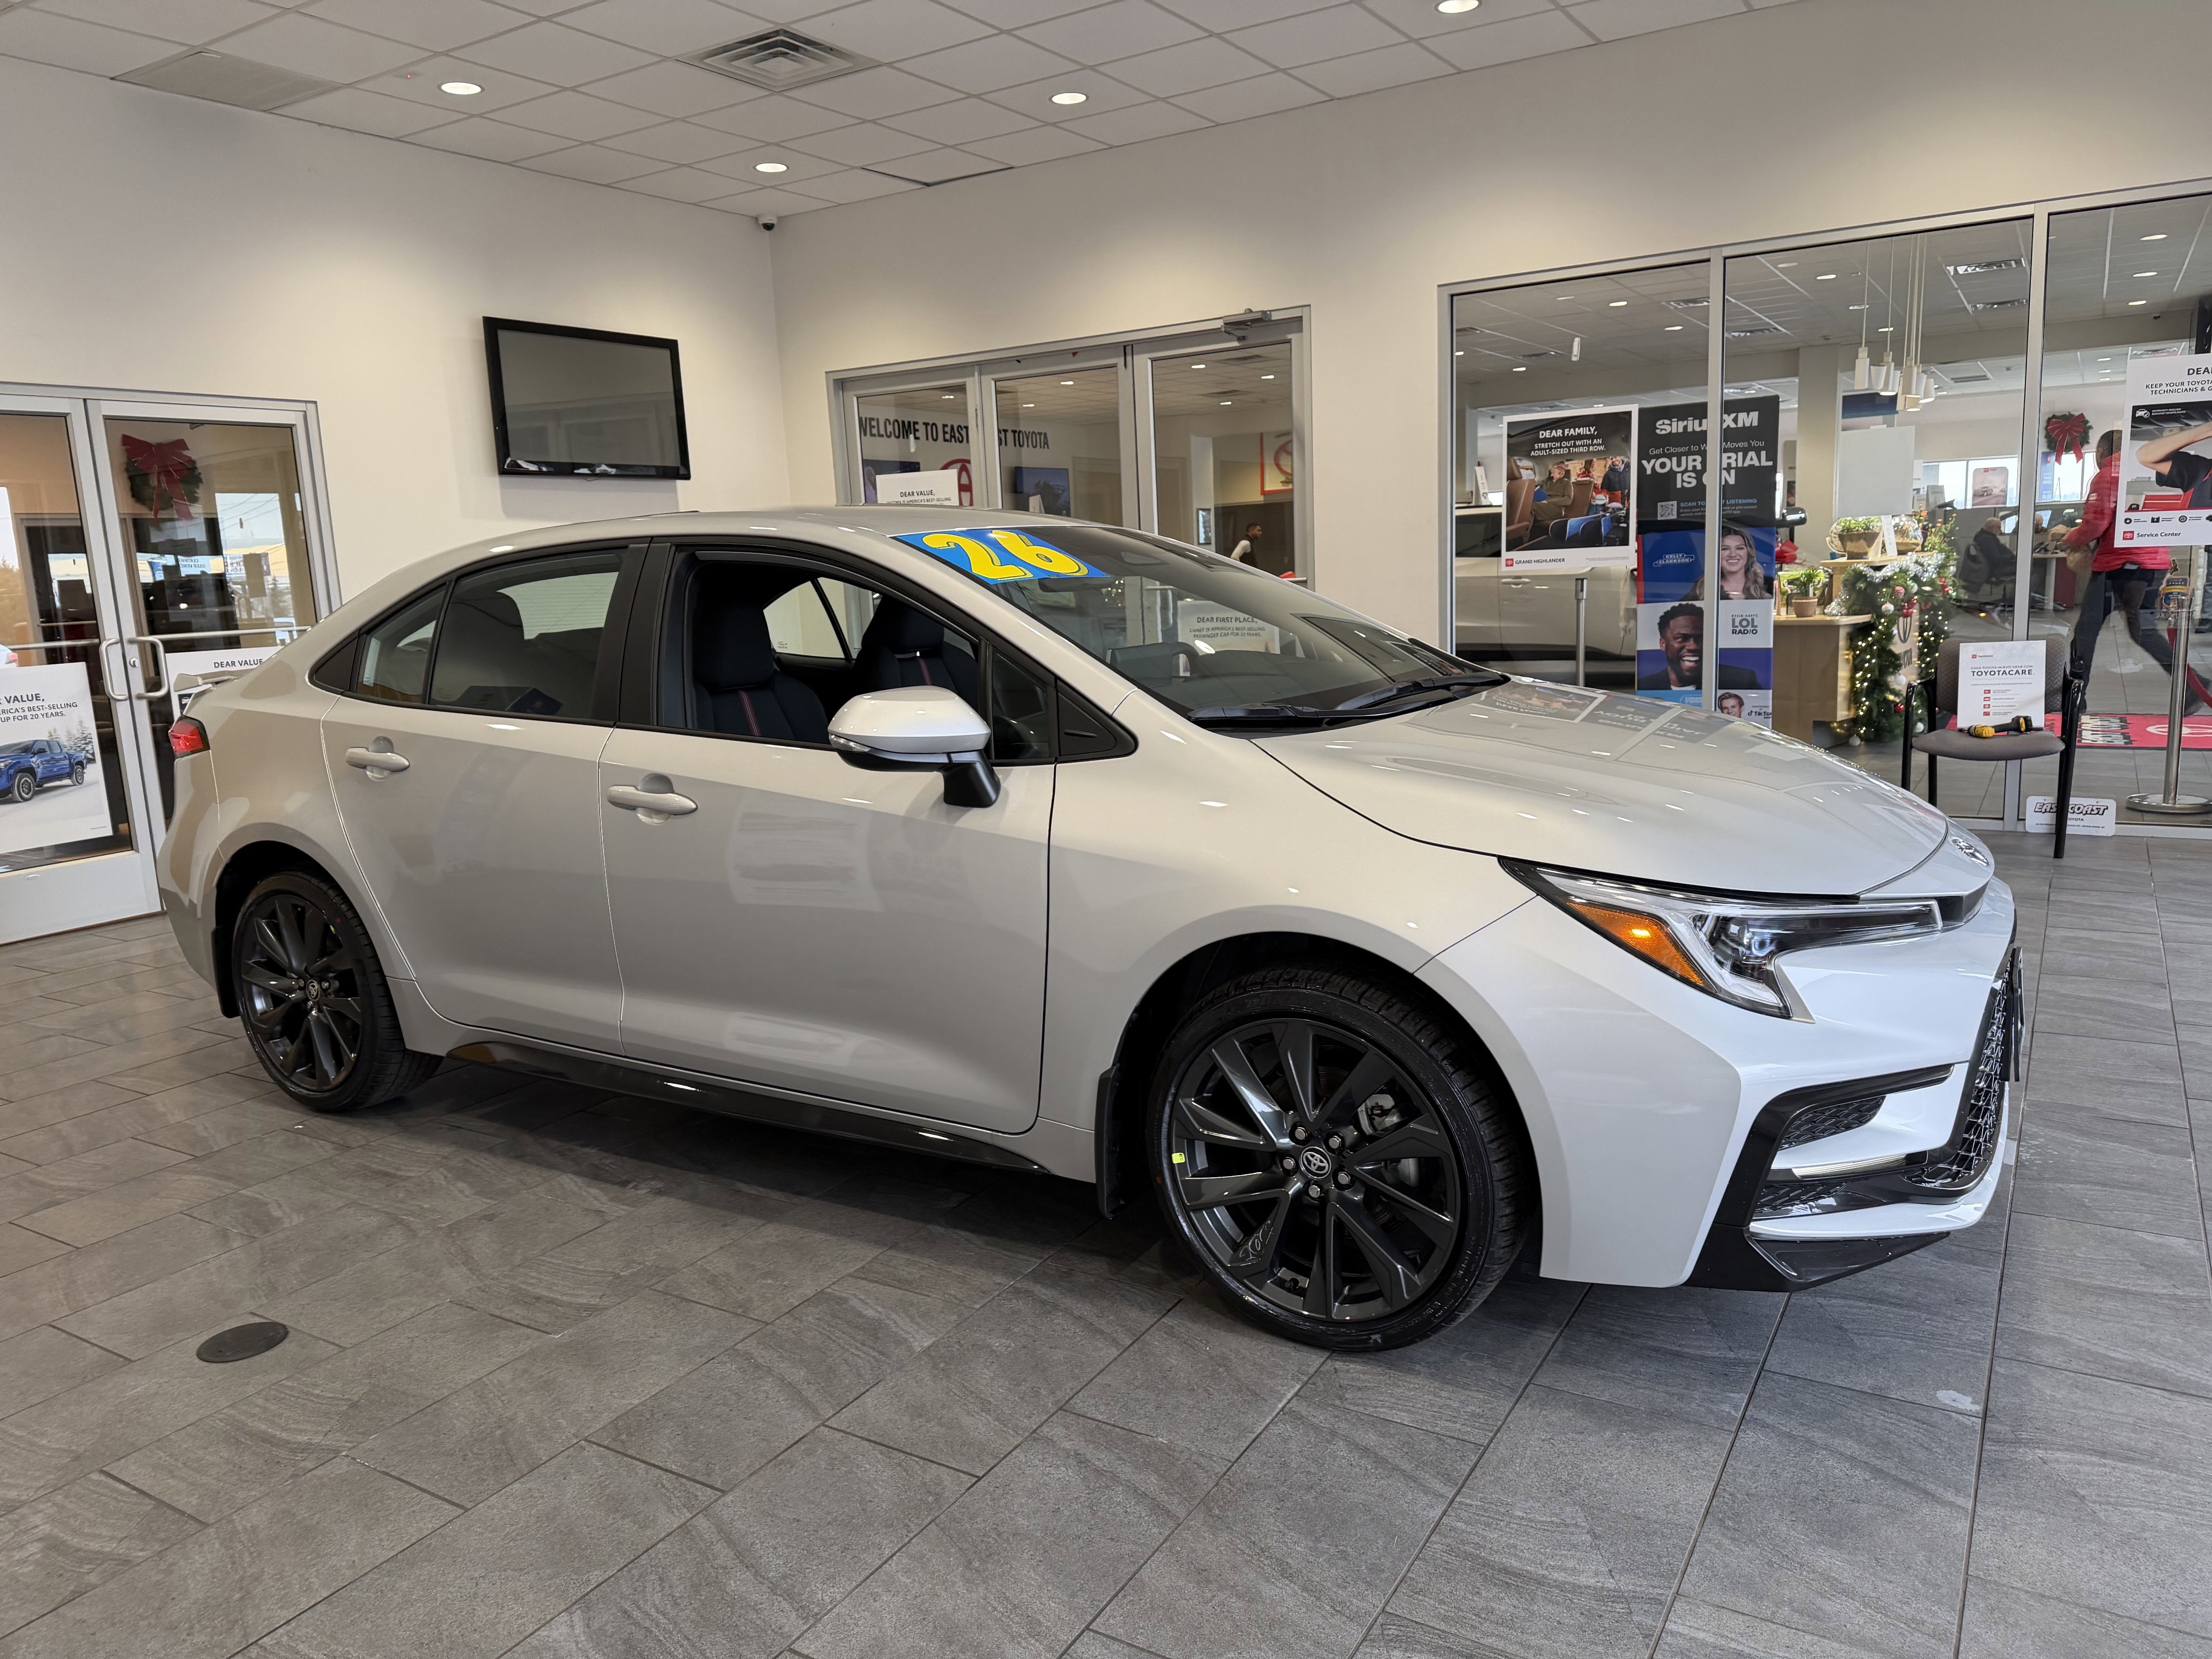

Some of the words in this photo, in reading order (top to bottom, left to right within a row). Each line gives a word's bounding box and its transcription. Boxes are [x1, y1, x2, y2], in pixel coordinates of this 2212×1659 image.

[2187, 367, 2212, 376] DEA
[2151, 386, 2198, 395] TECHNICIANS
[859, 417, 920, 440] WELCOME
[923, 422, 938, 441] TO
[1656, 411, 1759, 434] SiriuXM
[1539, 429, 1562, 438] DEAR
[1565, 426, 1597, 436] FAMILY,
[1011, 429, 1049, 449] TOYOTA
[1531, 448, 1568, 456] ADULT-SIZED
[1641, 455, 1702, 475] YOUR
[1723, 450, 1773, 468] RIAL
[1677, 472, 1697, 488] IS
[922, 530, 1089, 580] 26
[1731, 618, 1758, 628] LOL
[4, 693, 45, 704] VALUE,
[0, 707, 26, 715] RICA'S
[27, 702, 77, 712] BEST-SELLING
[2034, 802, 2057, 814] EAS
[2068, 804, 2108, 816] COAST
